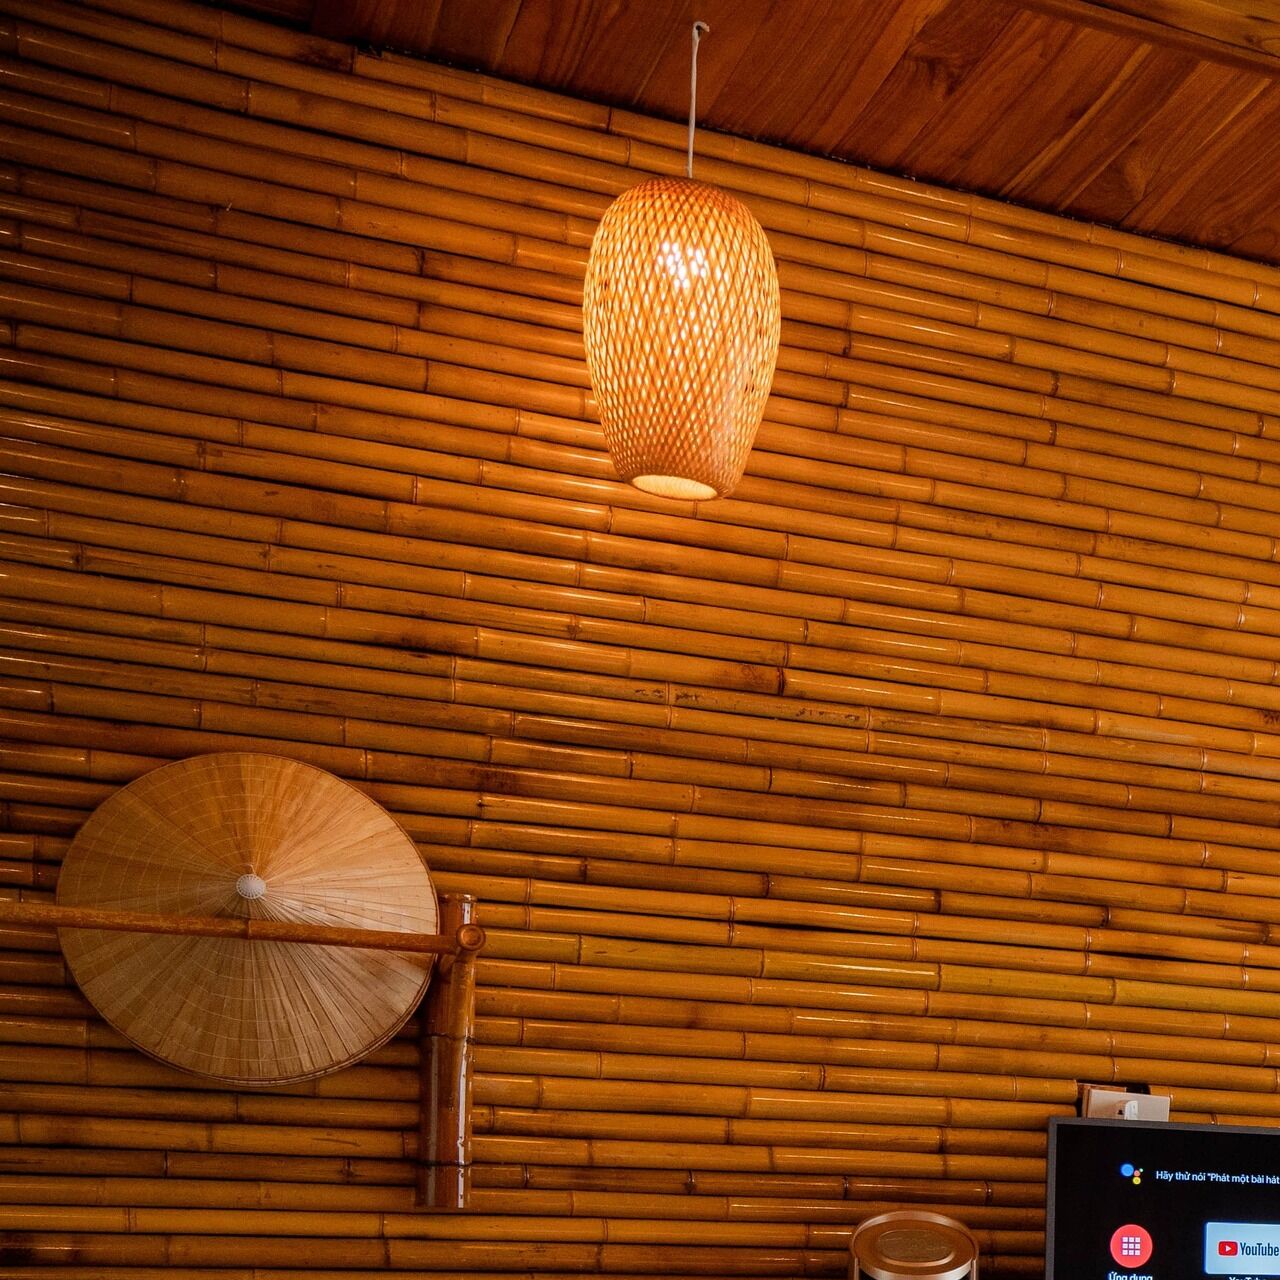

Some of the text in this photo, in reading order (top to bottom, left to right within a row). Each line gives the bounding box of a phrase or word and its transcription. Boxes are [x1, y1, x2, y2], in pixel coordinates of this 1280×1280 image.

[1192, 1173, 1206, 1182] nói
[1266, 1176, 1280, 1185] hát
[1240, 1242, 1279, 1256] YouTube
